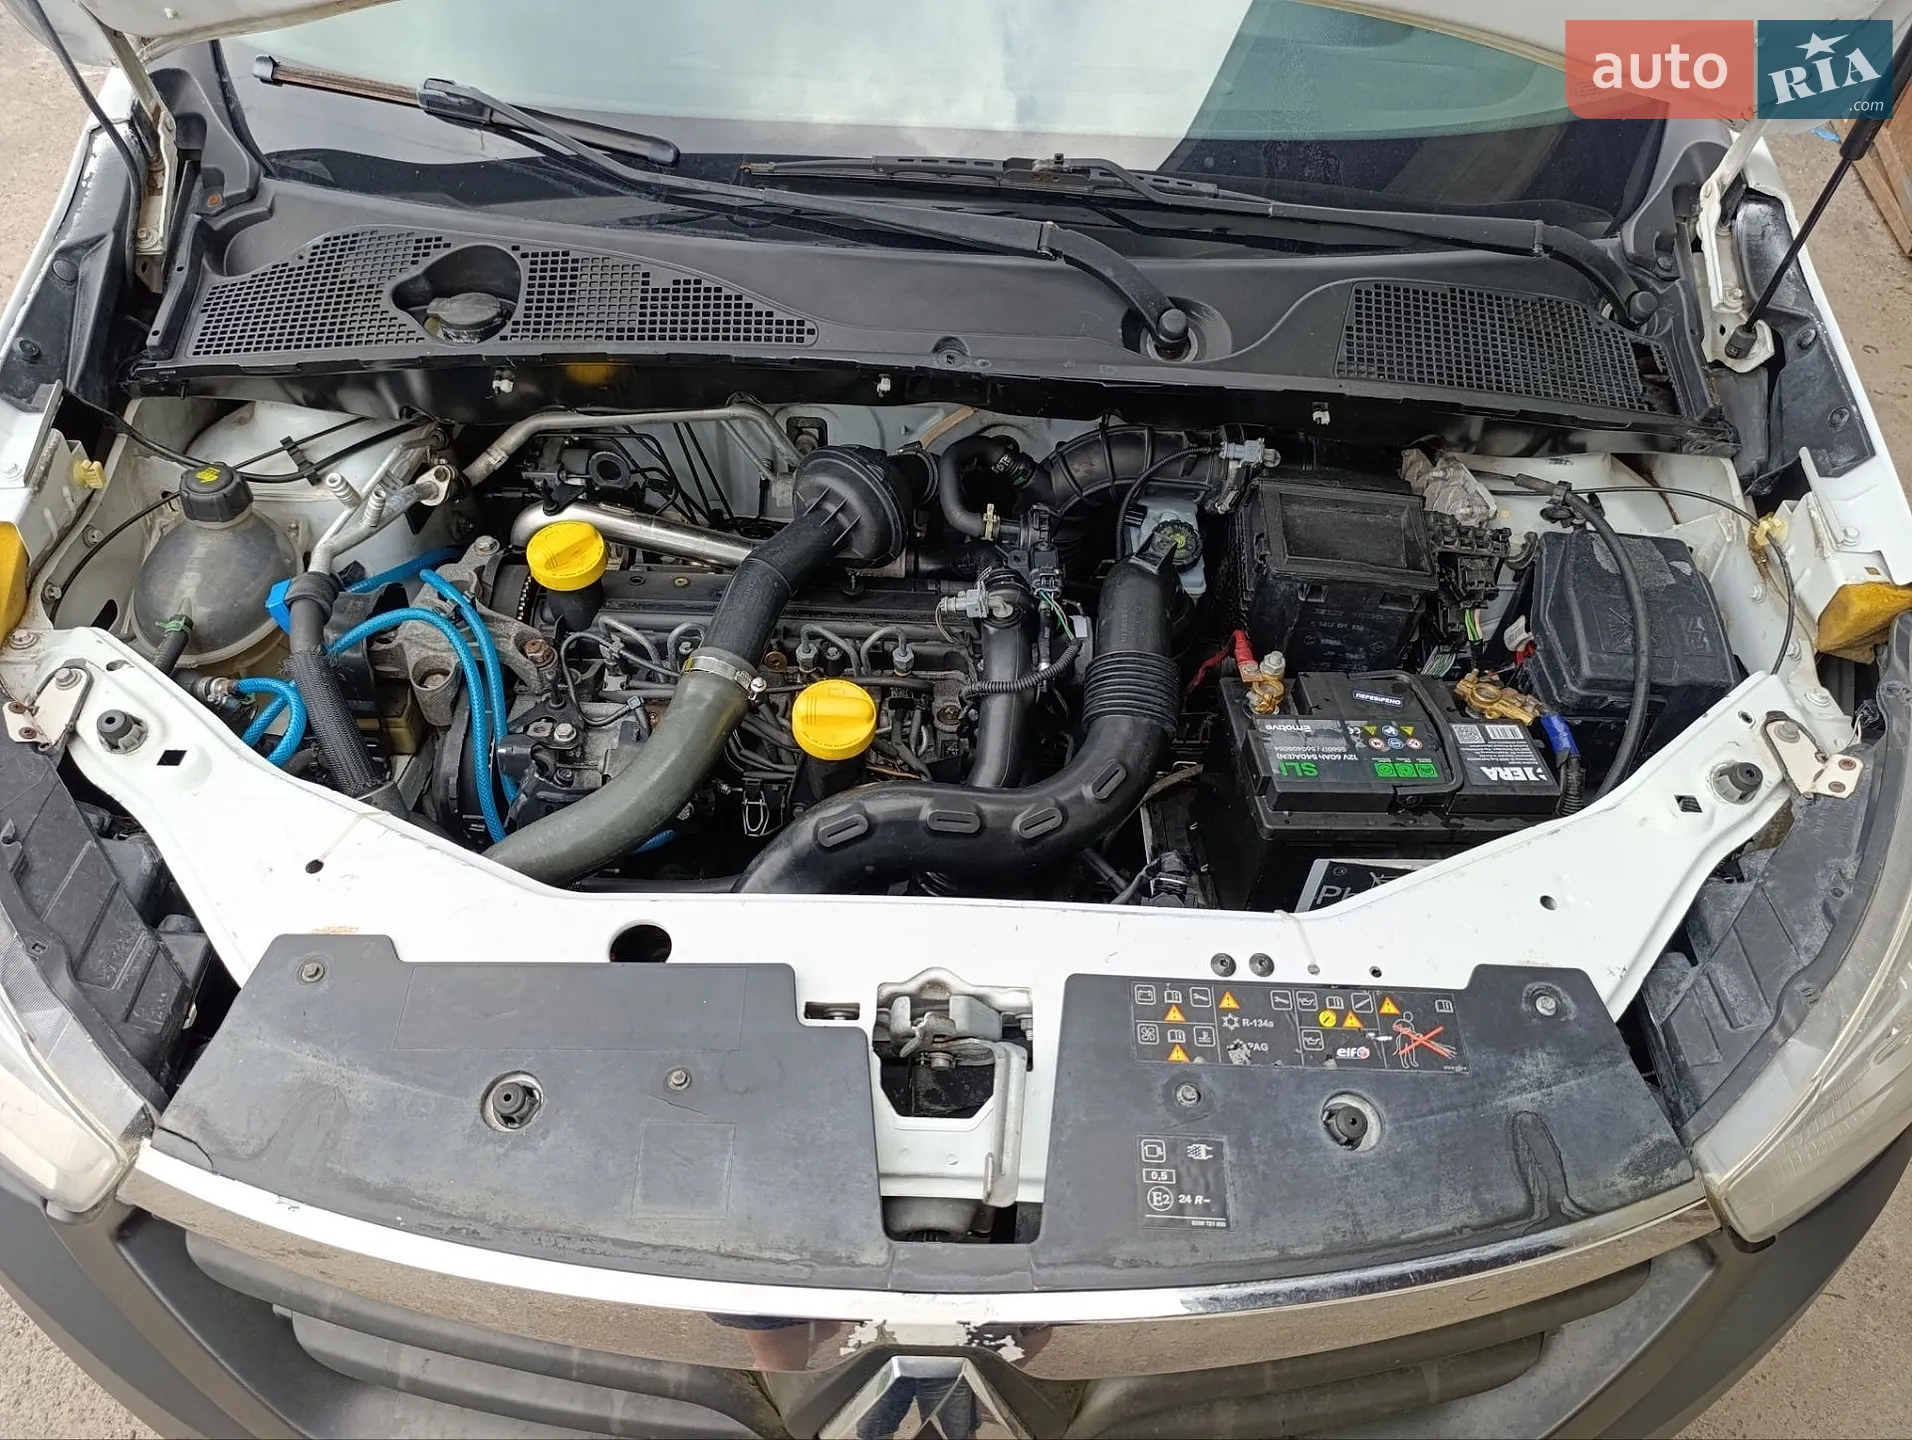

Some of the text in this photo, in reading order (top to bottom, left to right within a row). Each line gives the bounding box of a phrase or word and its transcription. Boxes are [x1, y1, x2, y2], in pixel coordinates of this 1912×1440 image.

[1265, 723, 1312, 733] Emotive
[1278, 761, 1319, 777] SLI
[1242, 1018, 1275, 1028] R-134a
[1336, 1046, 1359, 1058] elf
[1178, 1194, 1192, 1204] 24
